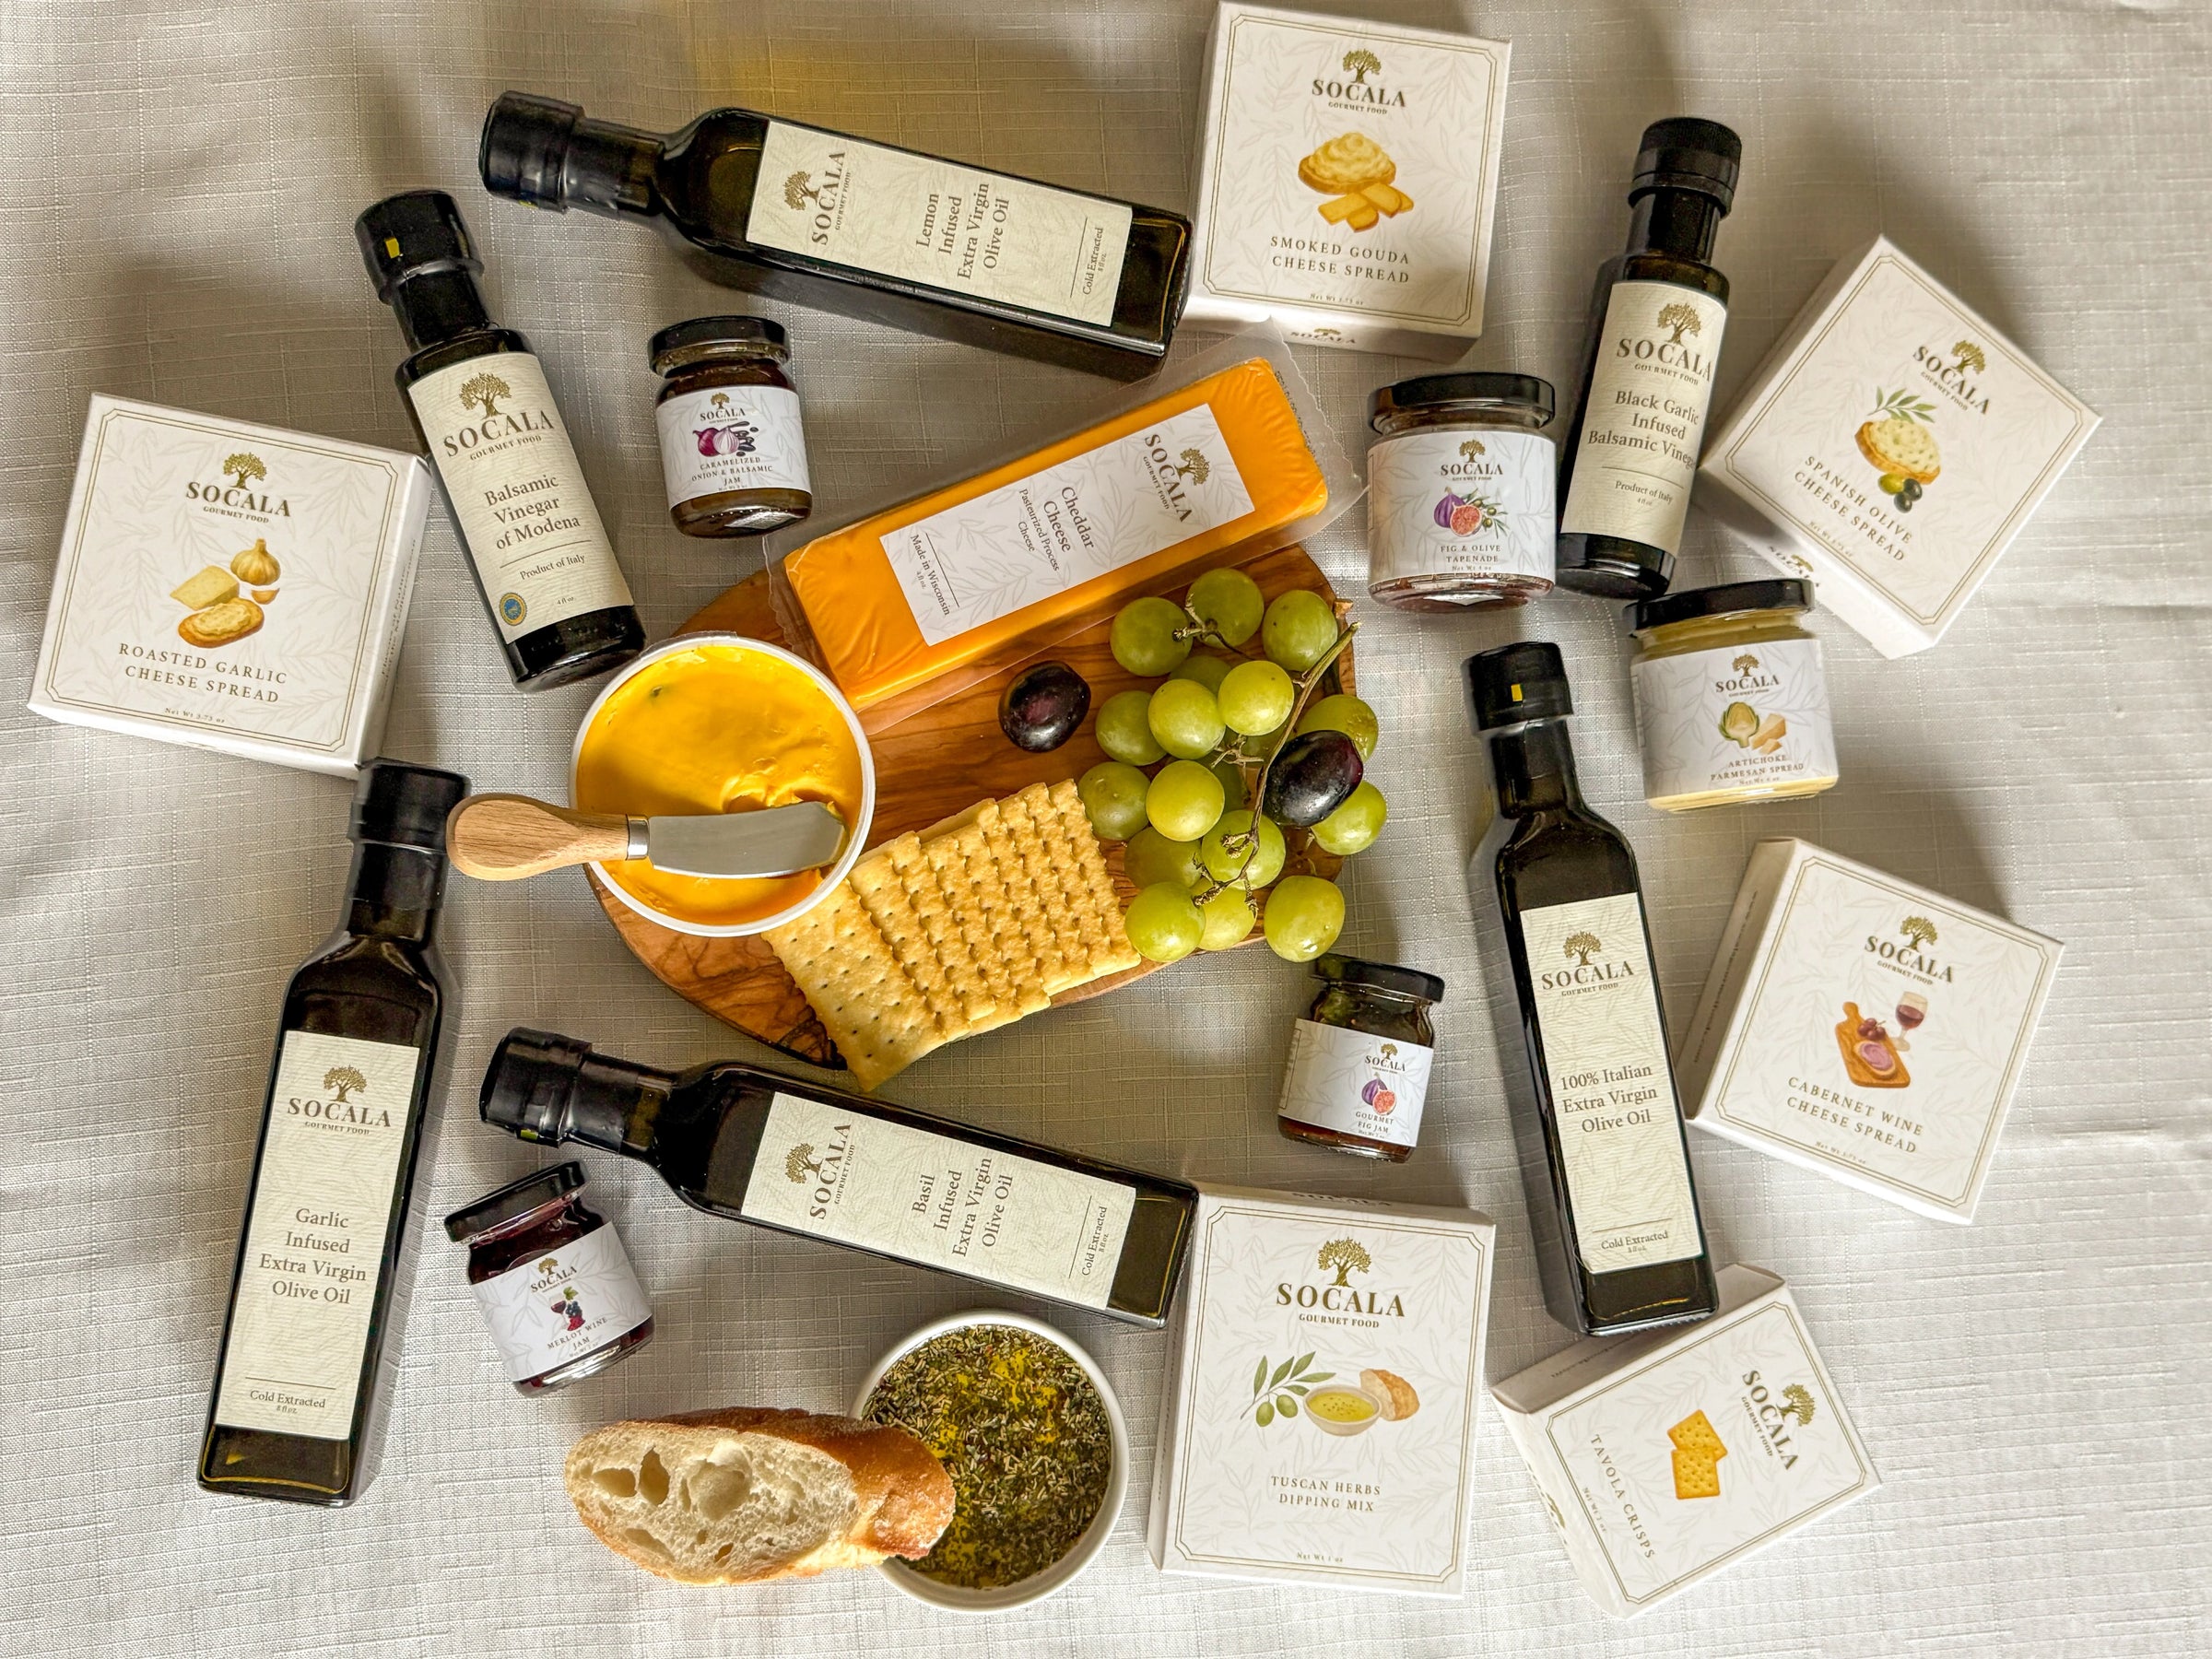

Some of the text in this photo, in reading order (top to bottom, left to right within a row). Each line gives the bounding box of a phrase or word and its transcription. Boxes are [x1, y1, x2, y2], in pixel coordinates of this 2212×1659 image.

[1312, 78, 1406, 108] SOCALA
[1328, 101, 1388, 115] GOURMET FOOD
[811, 151, 846, 245] SOCALA
[834, 171, 852, 230] GOURMET FOOD
[915, 193, 939, 249] Lemon
[937, 195, 962, 254] Infused
[958, 182, 990, 279] Extra Virgin
[983, 198, 1010, 269] Olive Oil
[1082, 227, 1104, 295] Cold Extracted
[1270, 235, 1409, 265] SMOKED GOUDA
[1272, 255, 1409, 283] CHEESE SPREAD
[1617, 338, 1712, 382] SOCALA
[1634, 363, 1699, 385] GOURMET FOOD
[1912, 345, 1992, 416] SOCALA
[1920, 371, 1969, 412] GOURMET FOOD
[700, 407, 746, 421] SOCALA
[1615, 390, 1700, 425] Black Garlic
[443, 410, 555, 457] SOCALA
[1587, 430, 1658, 452] Balsamic
[1631, 413, 1687, 440] Infused
[469, 435, 542, 461] GOURMET FOOD
[700, 456, 760, 470] CARAMELIZED
[692, 469, 718, 482] ONION
[730, 465, 773, 476] BALSAMIC
[724, 477, 741, 487] JAM
[1143, 455, 1171, 511] GOURMET FOOD
[1144, 433, 1194, 524] SOCALA
[1441, 463, 1504, 477] SOCALA
[185, 481, 291, 517] SOCALA
[484, 474, 559, 506] Balsamic
[1615, 480, 1649, 496] Product
[1658, 491, 1673, 505] Italy
[1805, 455, 1866, 507] SPANISH
[1868, 503, 1912, 545] OLIVE
[203, 505, 269, 524] GOURMET FOOD
[493, 496, 559, 524] Vinegar
[1060, 486, 1095, 549] Cheddar
[1794, 470, 1849, 518] CHEESE
[1851, 516, 1906, 562] SPREAD
[496, 515, 581, 550] of Modena
[1018, 488, 1061, 571] Pasteurized Process
[1018, 521, 1035, 552] Cheese
[1042, 500, 1071, 552] Cheese
[520, 554, 585, 580] Product of Italy
[1446, 555, 1499, 563] TAPENADE
[910, 533, 950, 616] Made in Wisconsin
[119, 643, 288, 684] ROASTED GARLIC
[125, 665, 279, 703] CHEESE SPREAD
[1715, 674, 1780, 693] SOCALA
[1711, 768, 1766, 782] PARMESAN
[1770, 762, 1805, 773] SPREAD
[1728, 754, 1787, 768] ARTICHOKE
[1865, 935, 1954, 983] SOCALA
[1877, 960, 1934, 986] GOURMET FOOD
[1541, 960, 1635, 991] SOCALA
[1561, 982, 1618, 996] GOURMET FOOD
[1364, 1054, 1406, 1072] SOCALA
[1560, 1065, 1653, 1091] 100% Italian
[287, 1098, 391, 1127] SOCALA
[1562, 1087, 1658, 1114] Extra Virgin
[1788, 1077, 1924, 1136] CABERNET WINE
[304, 1121, 345, 1132] GOURMET
[1355, 1112, 1394, 1124] GOURMET
[1374, 1124, 1389, 1134] JAM
[1582, 1109, 1651, 1134] Olive Oil
[1786, 1096, 1850, 1128] CHEESE
[1853, 1123, 1917, 1153] SPREAD
[809, 1123, 852, 1220] SOCALA
[833, 1144, 856, 1205] GOURMET FOOD
[911, 1174, 936, 1216] Basil
[932, 1171, 962, 1231] Infused
[951, 1157, 993, 1258] Extra Virgin
[295, 1207, 348, 1229] Garlic
[982, 1174, 1014, 1247] Olive Oil
[285, 1231, 350, 1253] Infused
[1081, 1206, 1108, 1277] Cold Extracted
[1601, 1230, 1669, 1250] Cold Extracted
[259, 1253, 367, 1282] Extra Virgin
[530, 1266, 578, 1293] SOCALA
[272, 1280, 350, 1304] Olive Oil
[1277, 1283, 1406, 1317] SOCALA
[547, 1317, 607, 1349] MERLOT WINE
[1299, 1312, 1380, 1328] GOURMET FOOD
[573, 1336, 589, 1351] JAM
[250, 1390, 325, 1408] Cold Extracted
[1740, 1395, 1773, 1457] GOURMET FOOD
[1742, 1369, 1800, 1471] SOCALA
[1271, 1476, 1382, 1495] TUSCAN HERBS
[1591, 1434, 1655, 1558] TAVOLA CRISPS
[1279, 1494, 1375, 1512] DIPPING MIX
